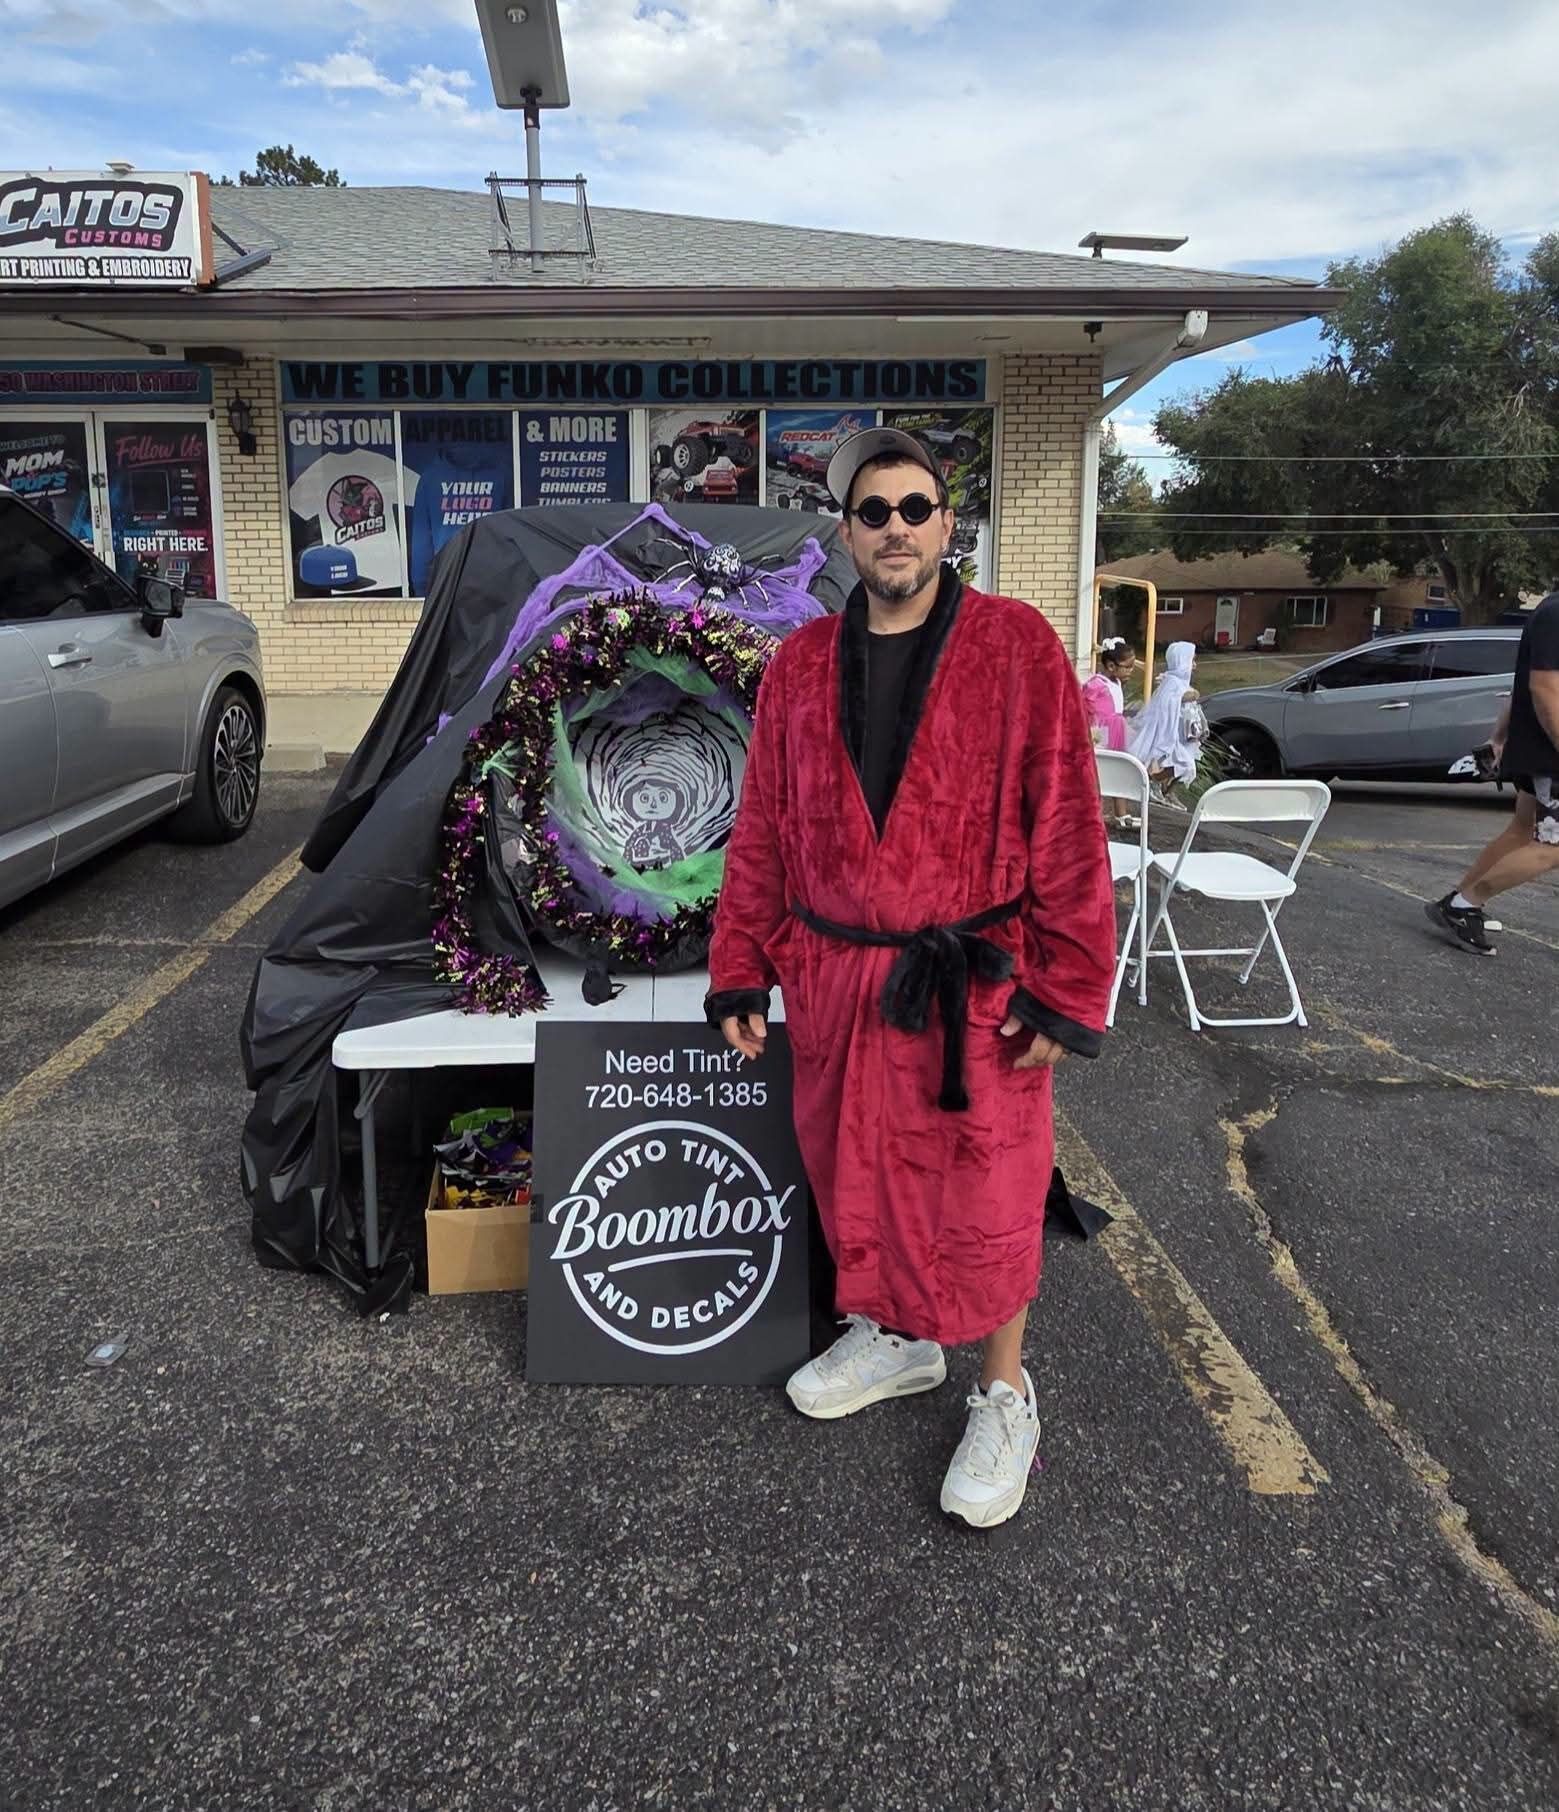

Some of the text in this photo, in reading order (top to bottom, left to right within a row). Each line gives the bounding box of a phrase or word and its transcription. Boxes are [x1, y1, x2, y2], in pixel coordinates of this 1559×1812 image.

[0, 188, 175, 236] CAITOS
[65, 228, 162, 248] CUSTOMS
[20, 258, 86, 277] PRINTING
[88, 260, 100, 277] &
[102, 259, 189, 278] EMBROIDERY
[289, 361, 979, 399] WE BUY FUNKO COLLECTIONS
[288, 418, 393, 446] CUSTOM
[526, 416, 618, 443] & MORE
[781, 431, 836, 443] REDCAT
[115, 432, 203, 467] Follow Us
[539, 451, 607, 463] STICKERS
[5, 449, 65, 478] MOM
[540, 466, 606, 478] POSTERS
[441, 481, 494, 496] YOUR
[540, 482, 607, 494] BANNERS
[441, 497, 493, 511] LOGO
[336, 515, 384, 543] CAITOS
[123, 536, 209, 552] RIGHT HERE.
[605, 1049, 745, 1074] Need Tint?
[585, 1082, 768, 1108] 720-648-1385
[593, 1139, 745, 1199] AUTO TINT
[548, 1182, 797, 1259] Boombox
[583, 1261, 759, 1329] AND DECALS
